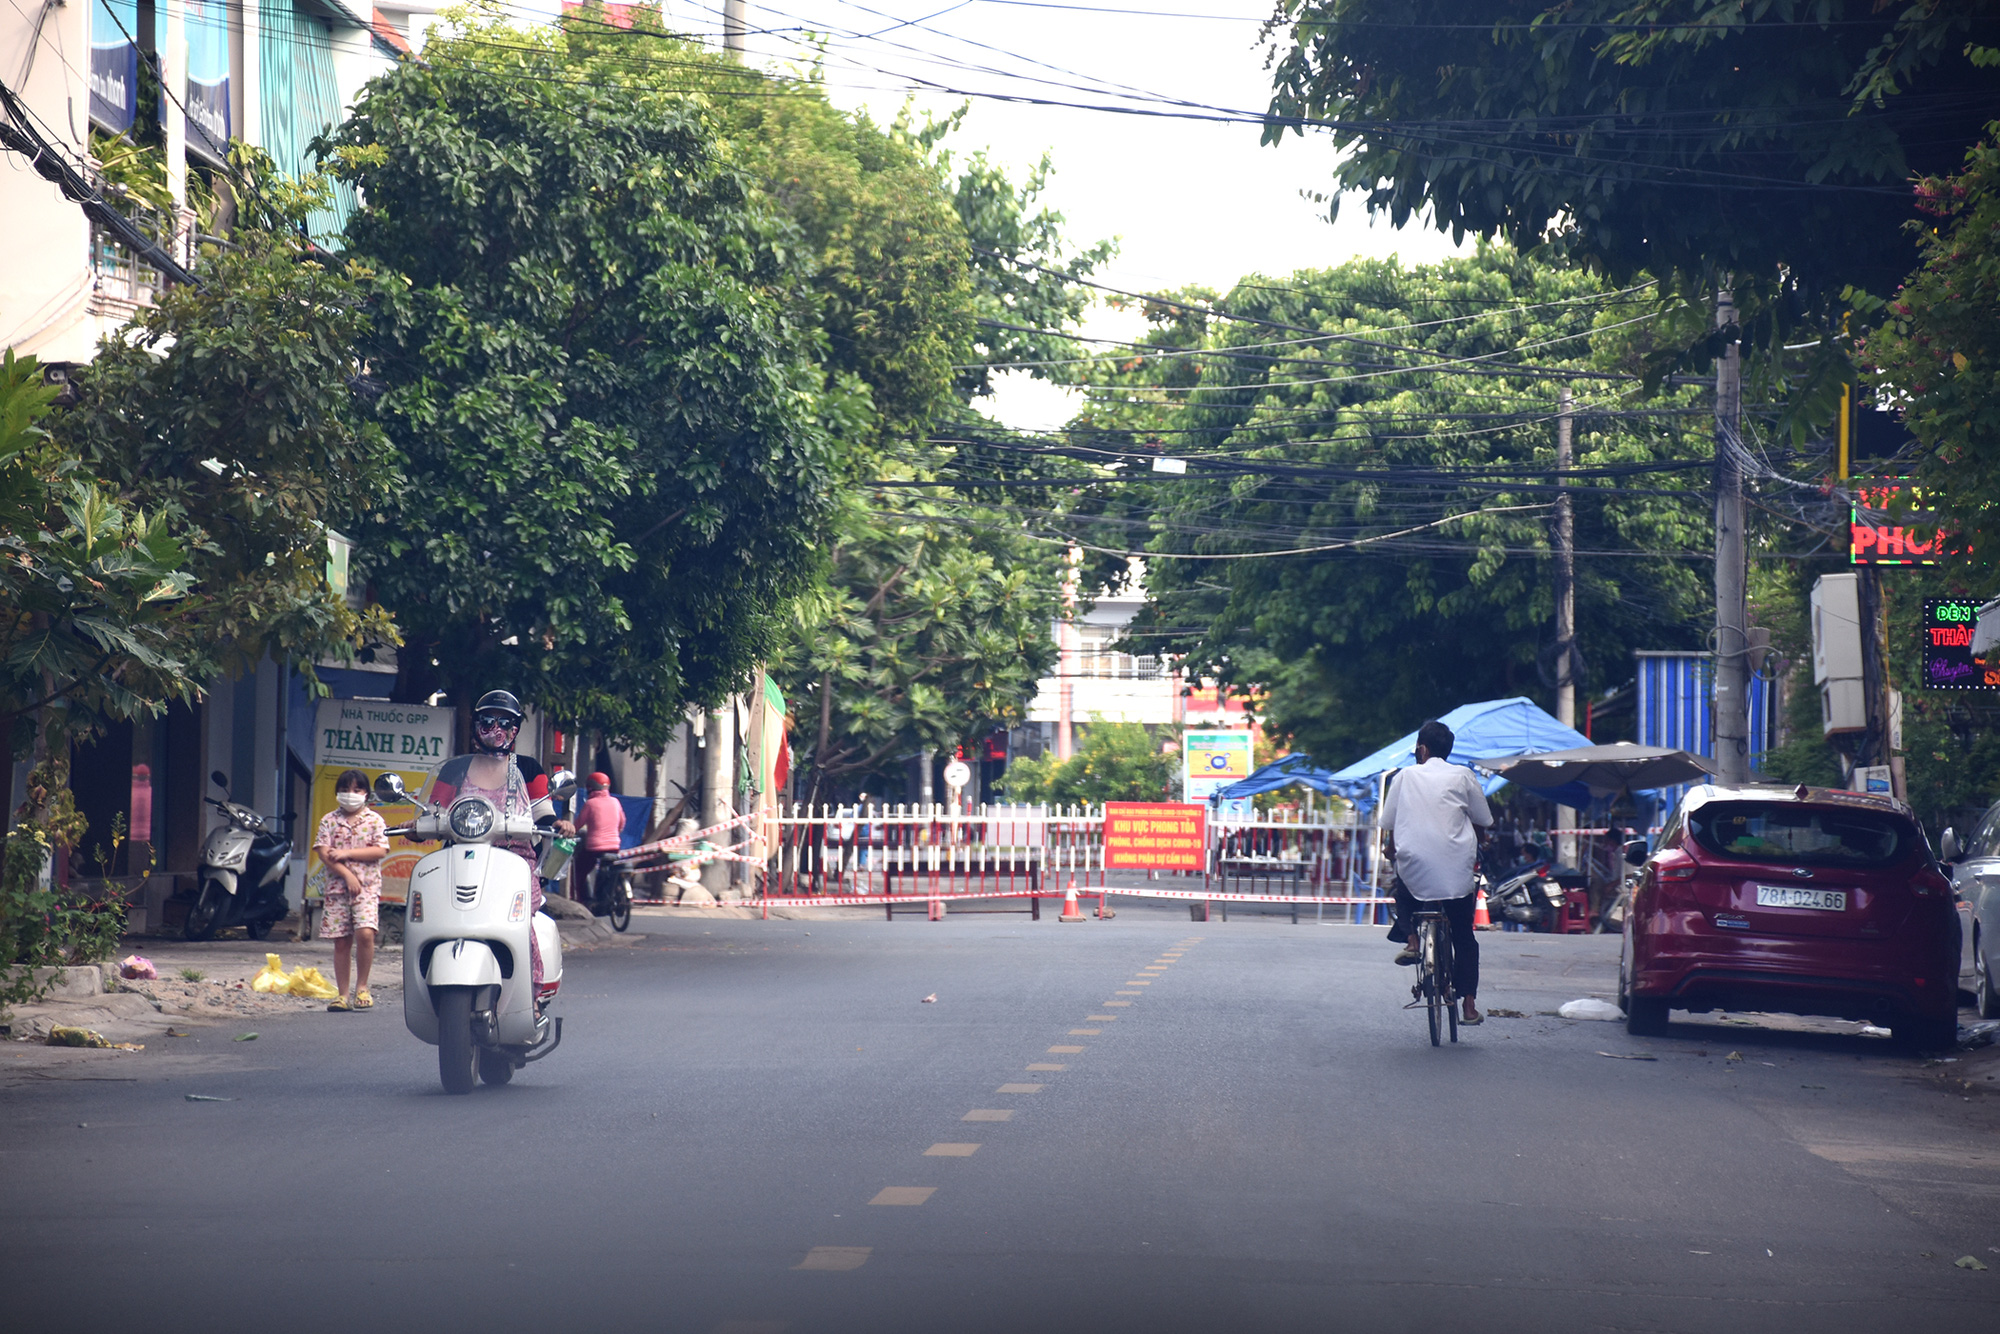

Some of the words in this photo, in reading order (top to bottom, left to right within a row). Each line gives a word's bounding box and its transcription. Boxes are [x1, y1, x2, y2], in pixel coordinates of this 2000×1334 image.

[341, 706, 363, 720] NHÀ
[367, 708, 404, 723] THUỐC
[406, 713, 429, 724] GPP
[323, 725, 395, 753] THÀNH
[401, 734, 443, 760] ĐẠT
[1113, 820, 1131, 833] KHU
[1132, 820, 1149, 835] VỰC
[1151, 820, 1178, 834] PHONG
[1180, 818, 1196, 834] TỎA
[1108, 835, 1132, 847] PHÒNG,
[1134, 835, 1155, 848] CHỐNG
[1156, 837, 1171, 850] DỊCH
[1173, 838, 1201, 849] COVID-19
[1113, 852, 1137, 864] (KHÔNG
[1138, 852, 1155, 865] PHẬN
[1156, 853, 1165, 865] SỰ
[1166, 851, 1181, 865] CẤM
[1181, 853, 1197, 865] VÀO)
[1760, 887, 1844, 909] 78A-024.66
